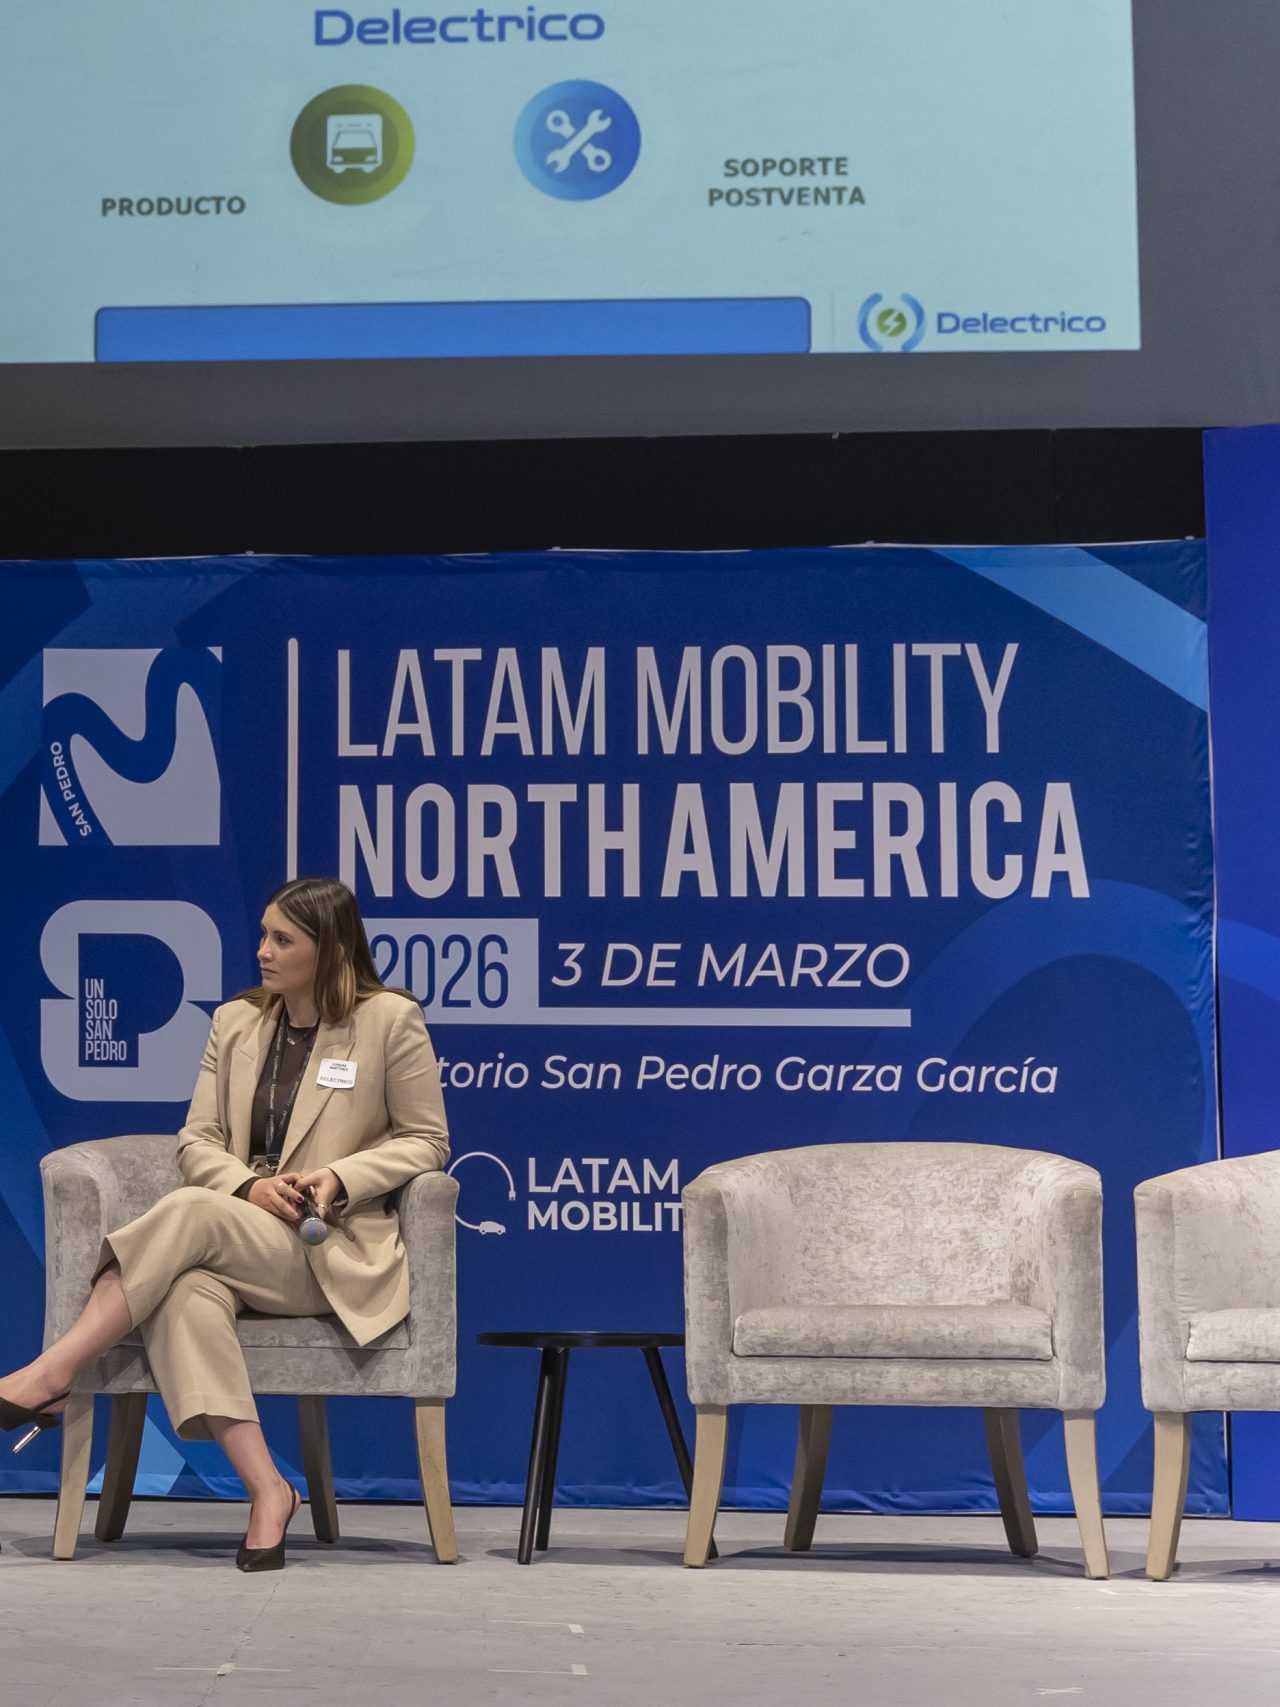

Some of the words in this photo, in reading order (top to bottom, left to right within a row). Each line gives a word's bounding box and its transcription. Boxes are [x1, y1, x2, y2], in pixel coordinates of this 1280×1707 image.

[315, 6, 605, 47] Delectrico
[724, 156, 849, 178] SOPORTE
[101, 195, 246, 217] PRODUCTO
[708, 186, 866, 207] POSTVENTA
[937, 311, 1107, 335] Delectrico
[337, 646, 606, 757] LATAM
[636, 642, 1020, 756] MOBILITY
[50, 741, 76, 802] PEDRO
[68, 802, 92, 837] SAN
[339, 782, 641, 899] NORTH
[660, 780, 1091, 899] AMERICA
[369, 933, 509, 1009] 2026
[551, 942, 586, 988] 3
[600, 942, 682, 987] DE
[697, 943, 911, 988] MARZO
[85, 978, 104, 999] UN
[85, 999, 118, 1020] SOLO
[85, 1020, 113, 1040] SAN
[85, 1040, 127, 1061] PEDRO
[436, 1052, 529, 1089] torio
[540, 1054, 622, 1090] San
[636, 1054, 762, 1091] Pedro
[775, 1056, 903, 1093] Garza
[916, 1056, 1058, 1094] García
[528, 1157, 679, 1195] LATAM
[527, 1200, 683, 1232] MOBILIT
